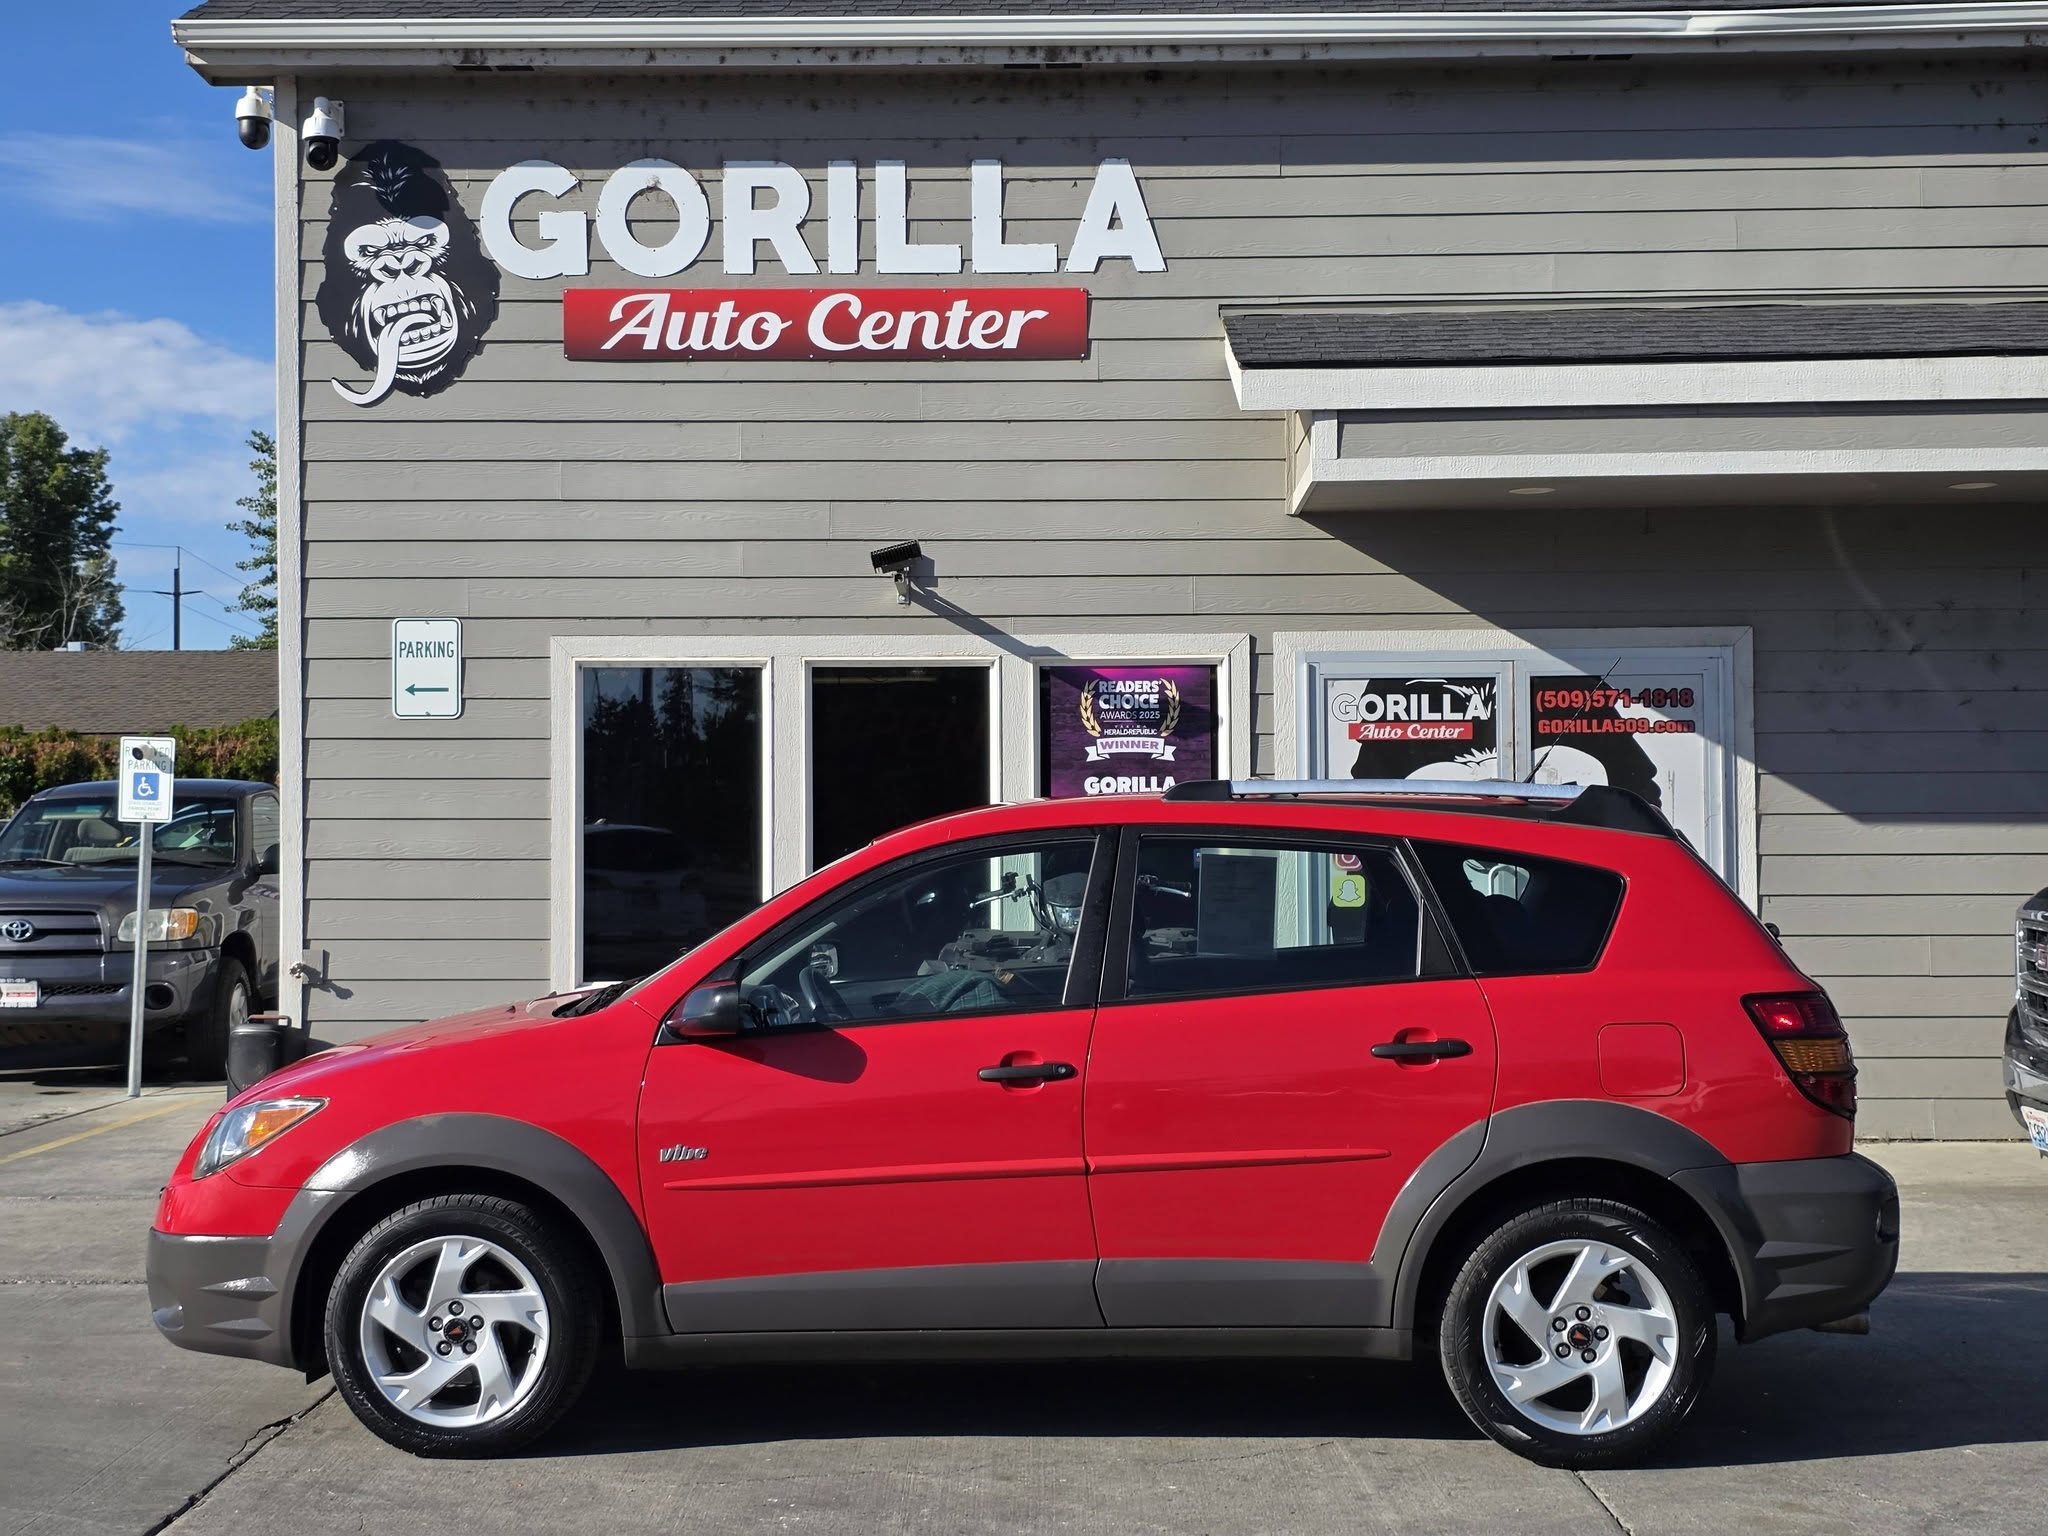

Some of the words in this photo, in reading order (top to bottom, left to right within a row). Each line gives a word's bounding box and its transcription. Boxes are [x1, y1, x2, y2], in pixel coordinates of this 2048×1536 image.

[480, 158, 1169, 279] GORILLA
[600, 293, 793, 351] Auto
[807, 292, 1050, 351] Center
[399, 641, 455, 658] PARKING
[1098, 680, 1162, 693] READERS'
[1098, 694, 1160, 709] CHOICE
[1332, 693, 1489, 722] GORILLA
[1536, 688, 1695, 712] (509)571-1818
[1100, 711, 1137, 720] AWARDS
[1139, 711, 1161, 719] 2025
[1358, 723, 1404, 739] Auto
[1406, 723, 1465, 739] Center
[1538, 718, 1696, 734] GORILLA509.com
[1100, 740, 1160, 750] WINNER
[128, 760, 167, 770] PARKING
[1084, 776, 1176, 795] GORILLA
